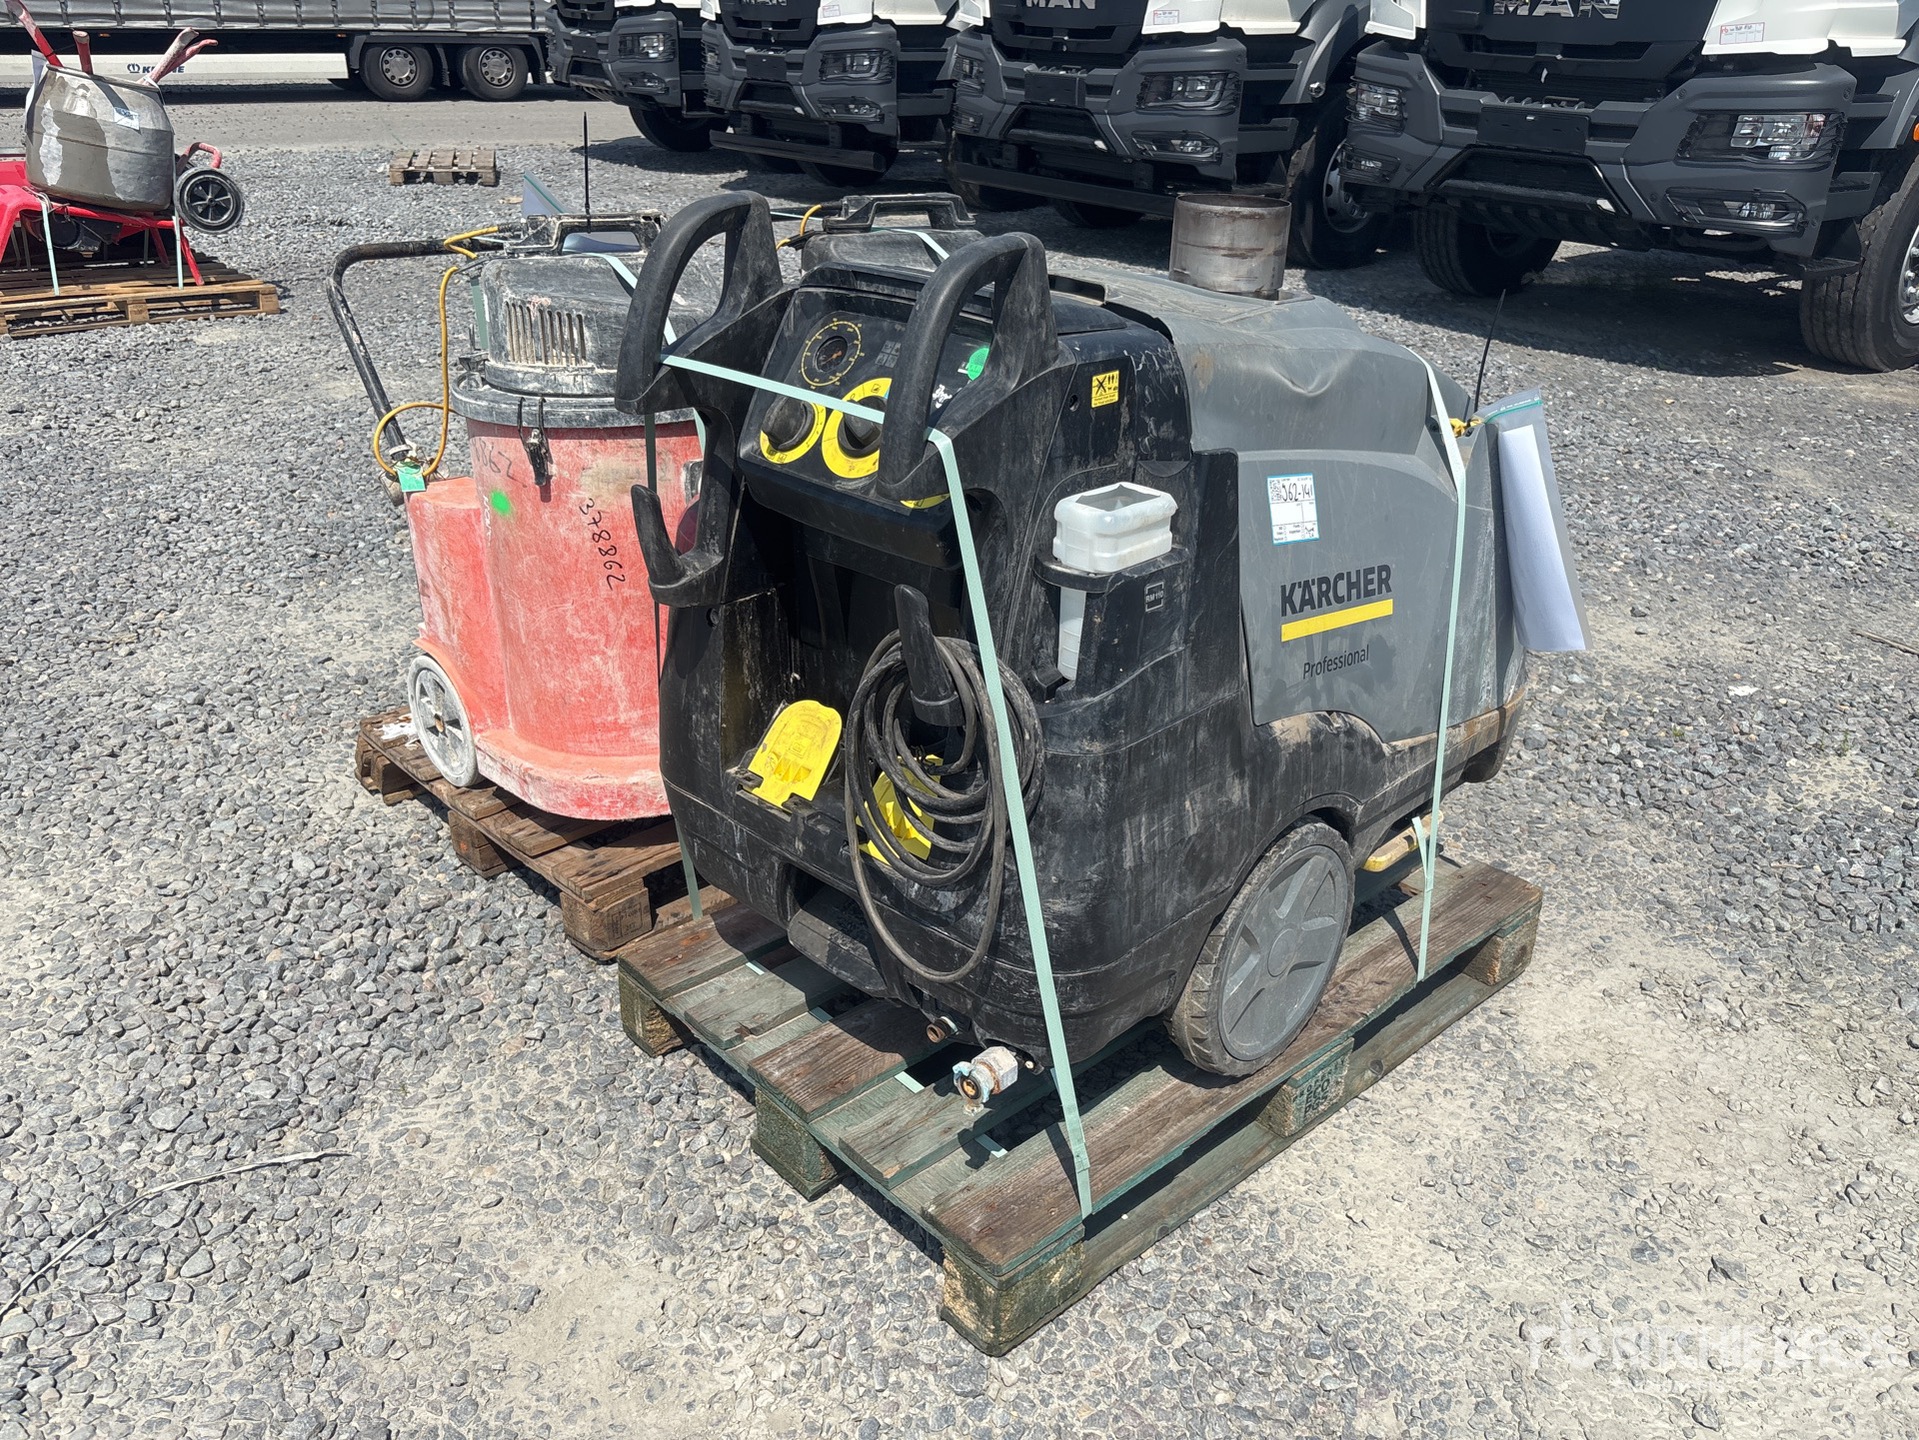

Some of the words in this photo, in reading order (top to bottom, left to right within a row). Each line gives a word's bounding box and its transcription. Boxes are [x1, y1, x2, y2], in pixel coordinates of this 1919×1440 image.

[1493, 0, 1620, 19] MAN
[578, 497, 626, 591] 378862
[1280, 563, 1393, 617] KÄRCHER
[1302, 643, 1370, 680] Professional
